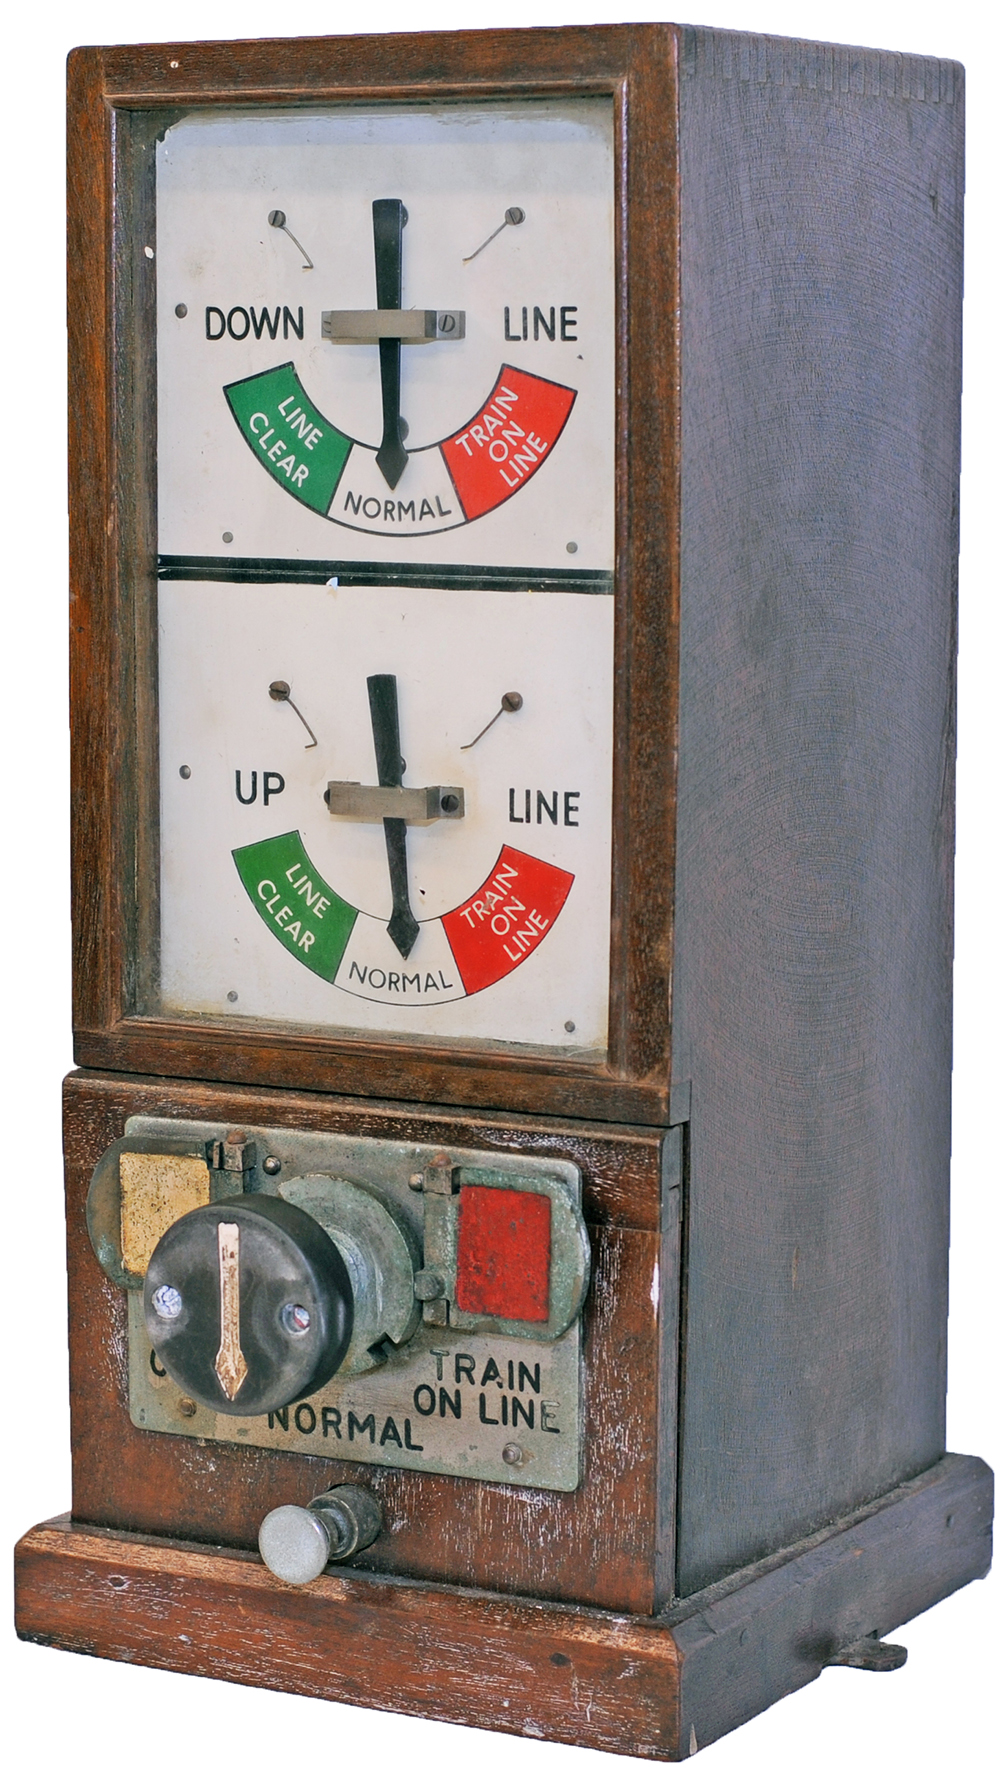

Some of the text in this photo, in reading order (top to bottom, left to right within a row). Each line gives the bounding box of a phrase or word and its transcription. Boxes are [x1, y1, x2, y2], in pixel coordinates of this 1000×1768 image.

[205, 305, 579, 342] DOWN LINE
[277, 395, 323, 451] LINE
[455, 386, 519, 457] TRAIN
[488, 420, 526, 463] ON
[249, 411, 309, 489] CLEAR
[499, 431, 549, 488] LINE
[343, 491, 452, 522] NORMAL
[235, 769, 581, 827] UP LINE
[257, 879, 316, 954] CLEAR
[284, 862, 331, 919] LINE
[459, 862, 519, 929] TRAIN
[489, 895, 526, 936] ON
[502, 908, 550, 962] LINE
[348, 961, 453, 994] NORMAL
[430, 1349, 541, 1394] TRAIN
[267, 1402, 424, 1452] NORMAL
[413, 1384, 561, 1434] ON LINE
